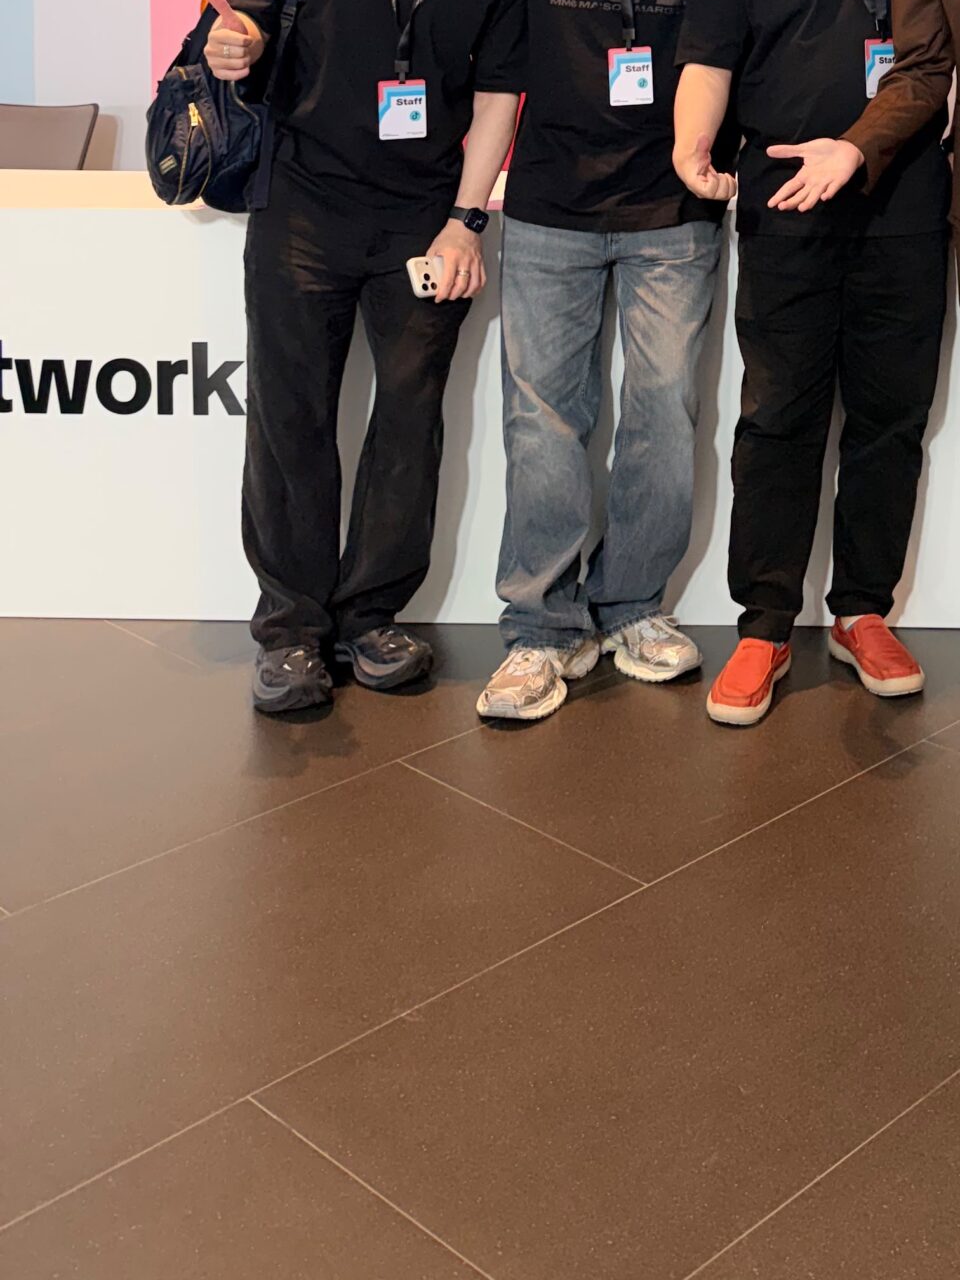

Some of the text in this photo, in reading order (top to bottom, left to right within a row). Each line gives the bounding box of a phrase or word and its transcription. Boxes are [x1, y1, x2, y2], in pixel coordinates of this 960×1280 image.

[878, 56, 896, 65] Staf
[625, 64, 650, 73] Staff
[396, 97, 423, 106] Staff
